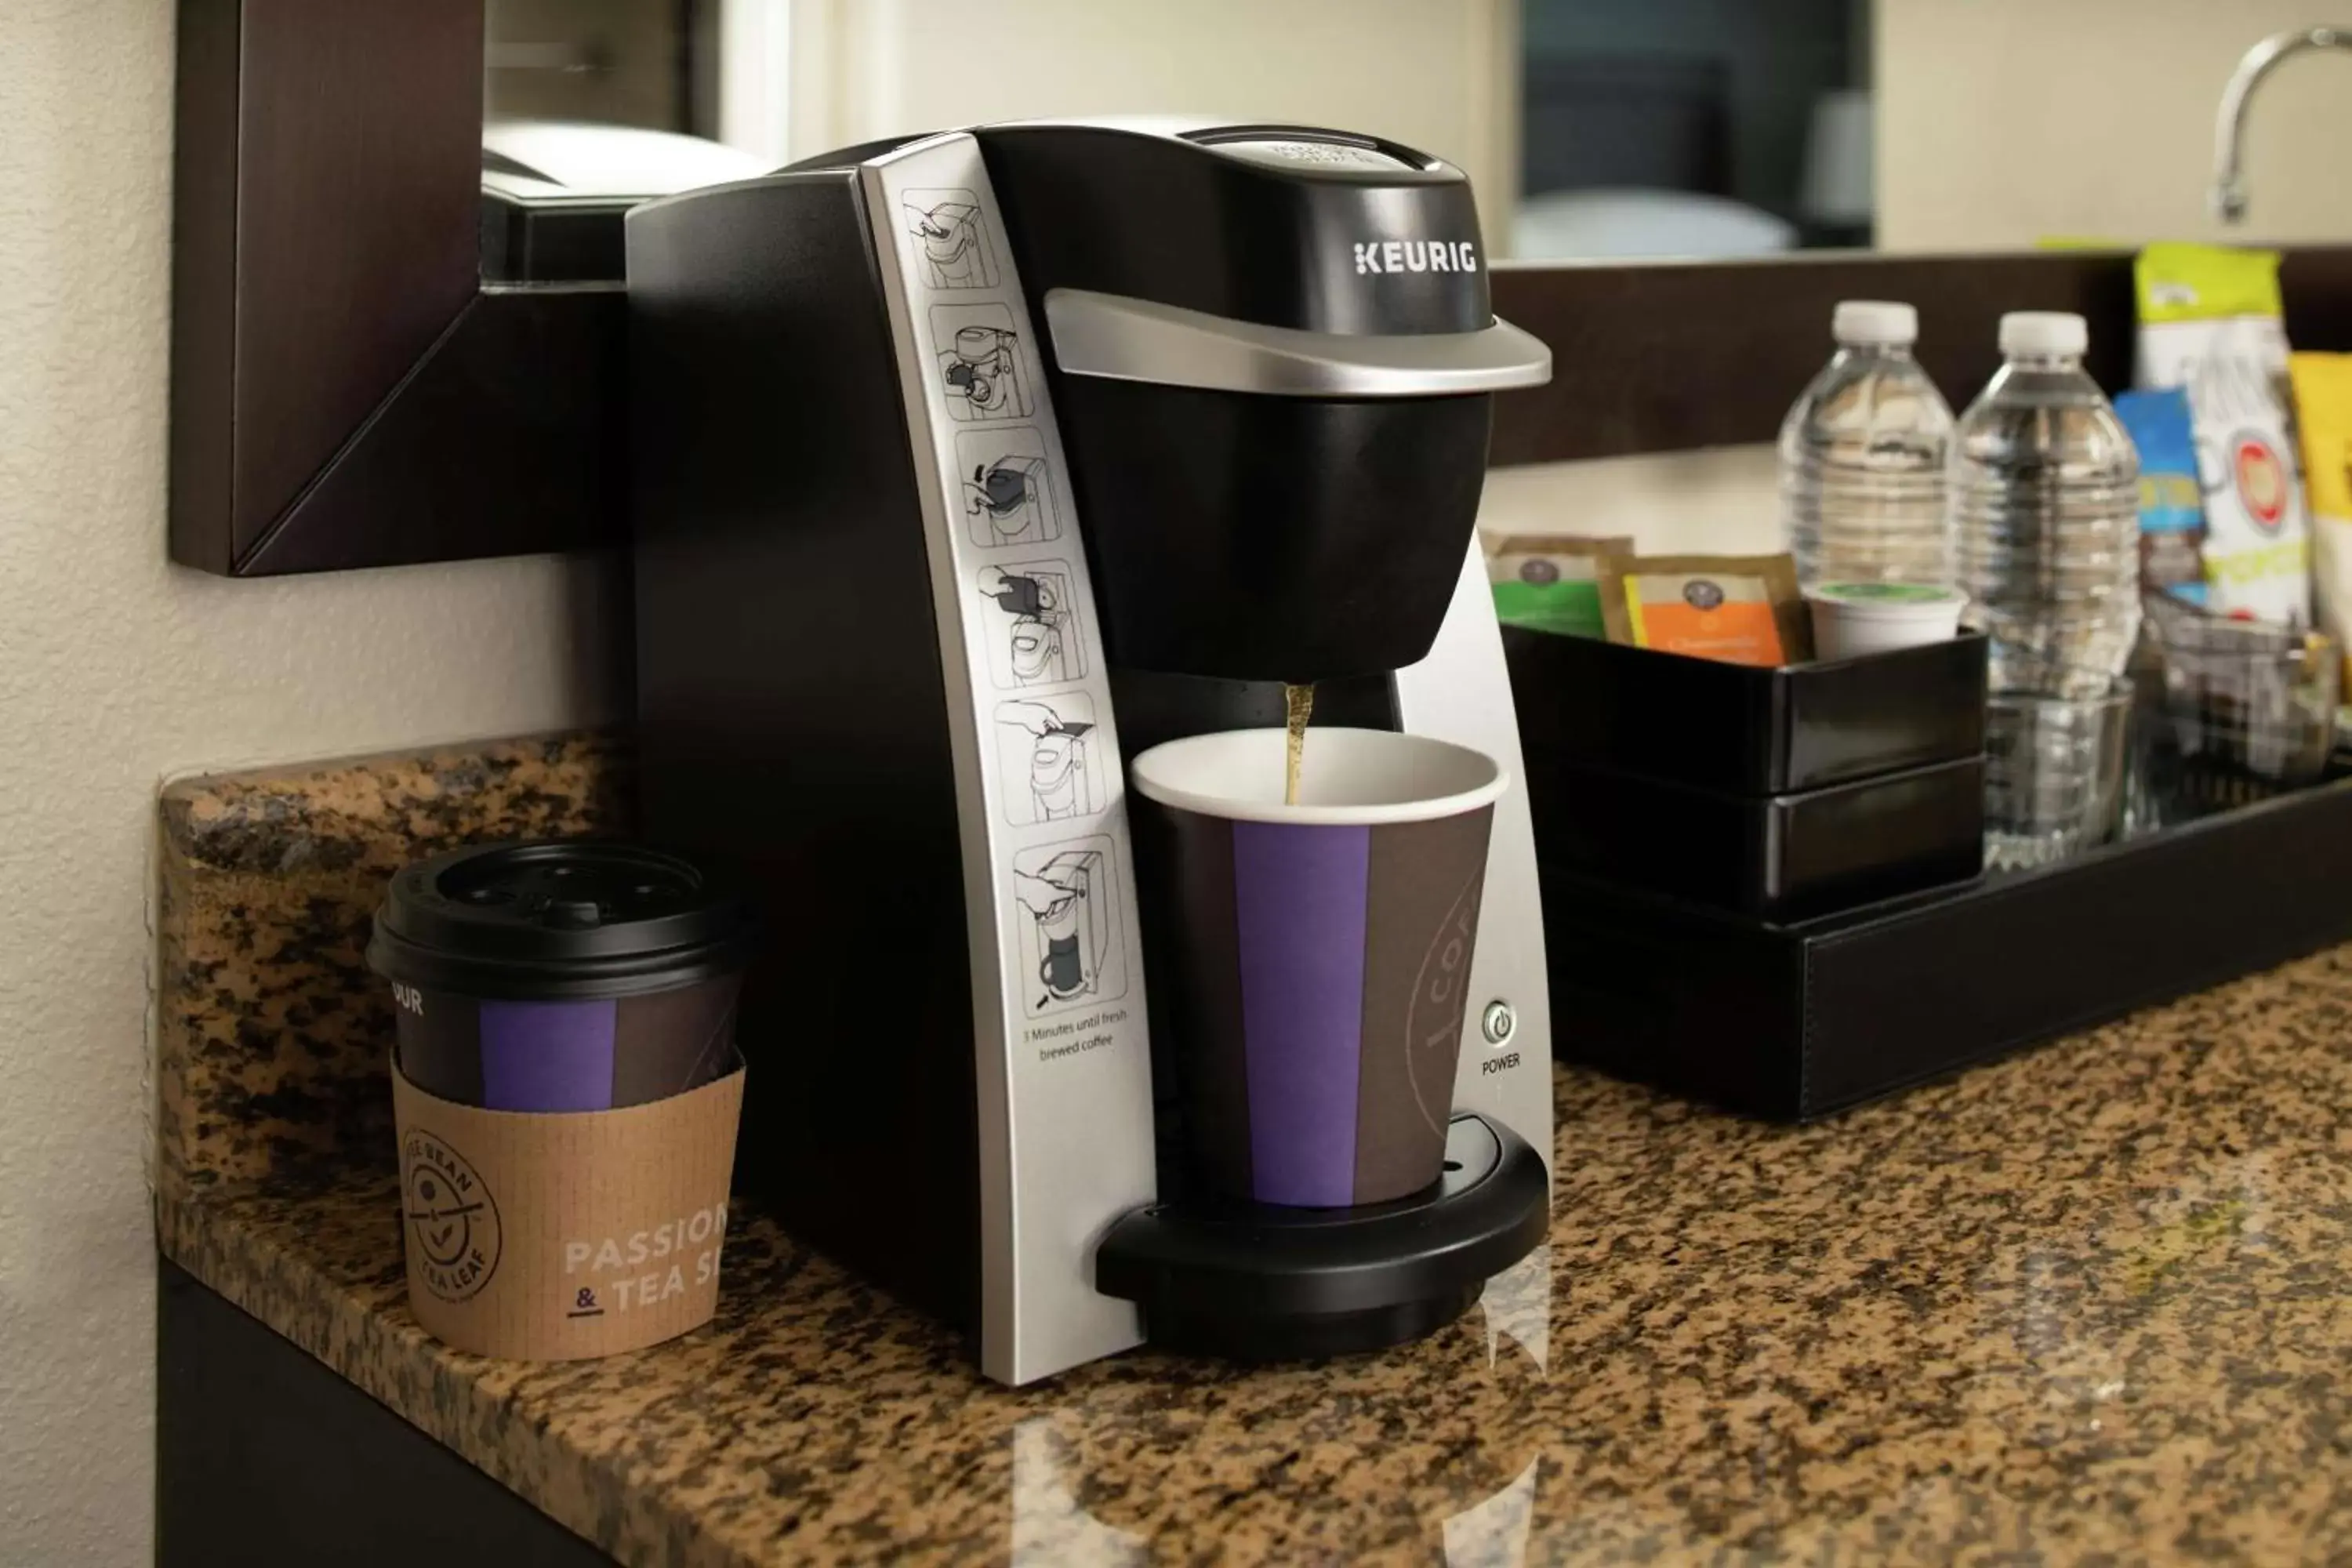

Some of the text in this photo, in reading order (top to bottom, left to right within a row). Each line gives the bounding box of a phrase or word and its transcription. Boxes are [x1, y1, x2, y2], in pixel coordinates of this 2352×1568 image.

[1355, 241, 1476, 274] KEURIG
[1032, 1023, 1074, 1042] Minutes
[1076, 1014, 1100, 1031] until
[1102, 1009, 1127, 1024] fresh
[1040, 1035, 1113, 1061] brewed coffee
[1483, 1053, 1520, 1076] POWER
[424, 1142, 472, 1192] BEAN
[450, 1248, 485, 1290] LEAF
[576, 1287, 597, 1308] &
[612, 1265, 685, 1313] TEA
